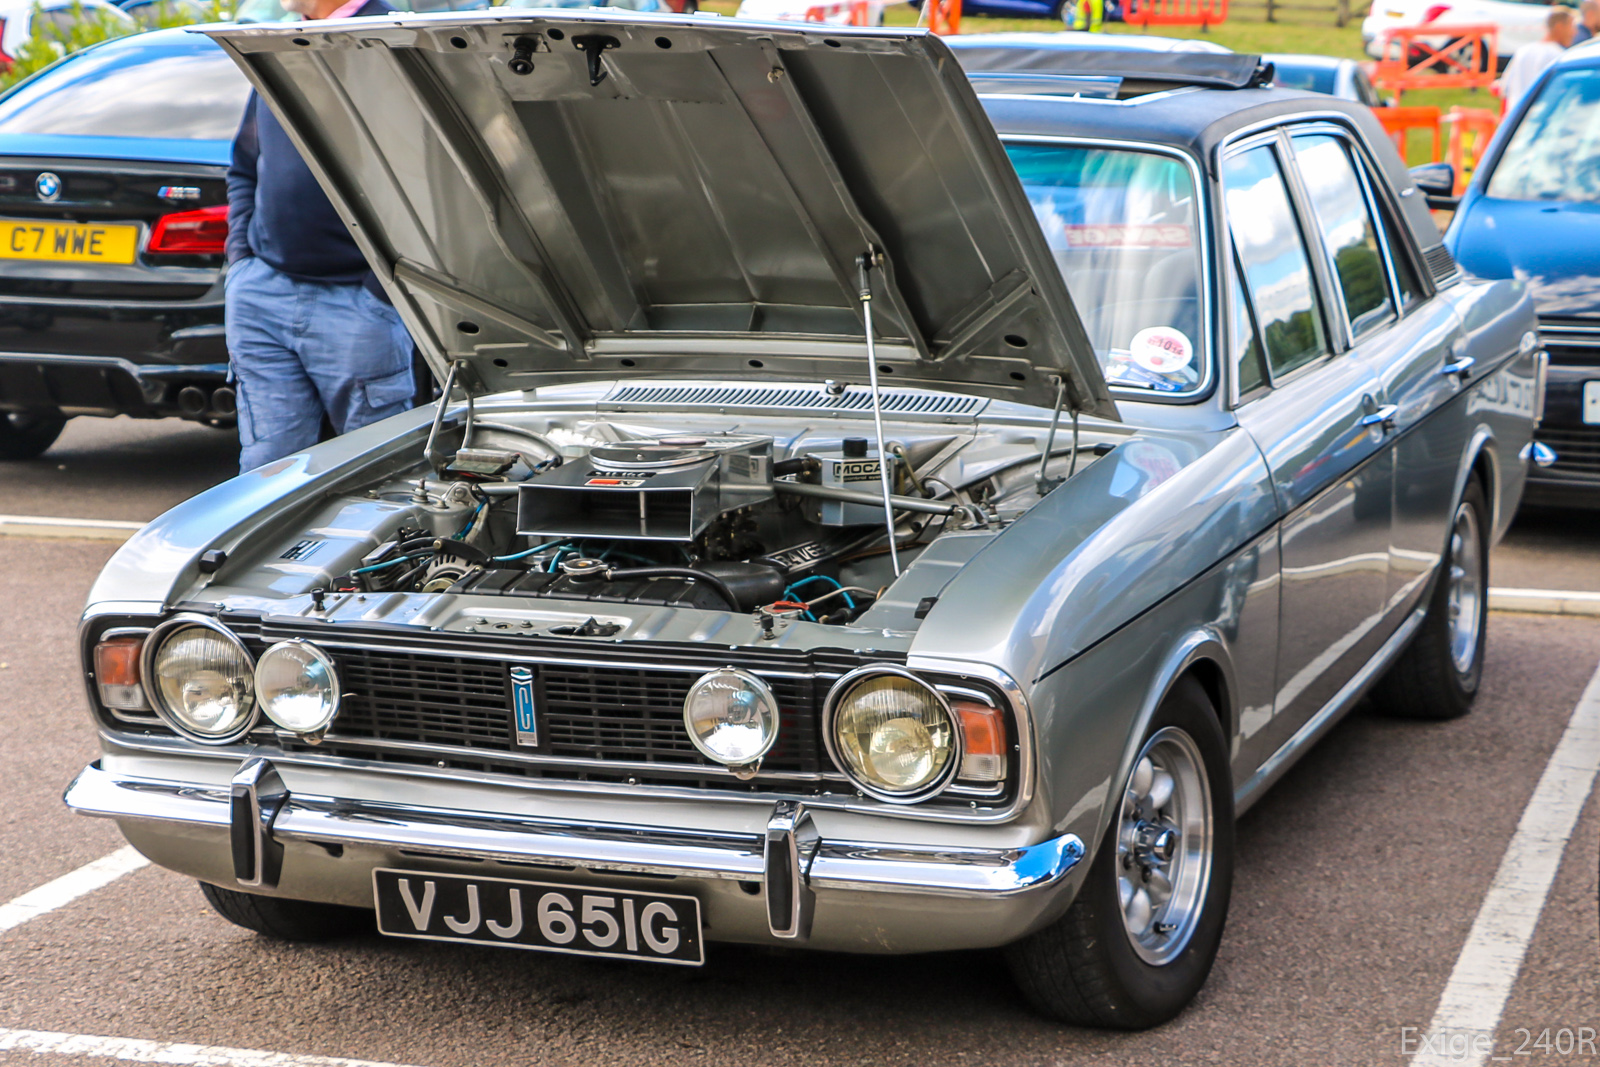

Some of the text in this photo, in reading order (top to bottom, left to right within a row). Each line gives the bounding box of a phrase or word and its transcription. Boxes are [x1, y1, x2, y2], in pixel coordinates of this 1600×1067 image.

[11, 226, 106, 255] C7 WWE
[836, 463, 885, 475] MOCA
[398, 878, 680, 954] VJJ 651G
